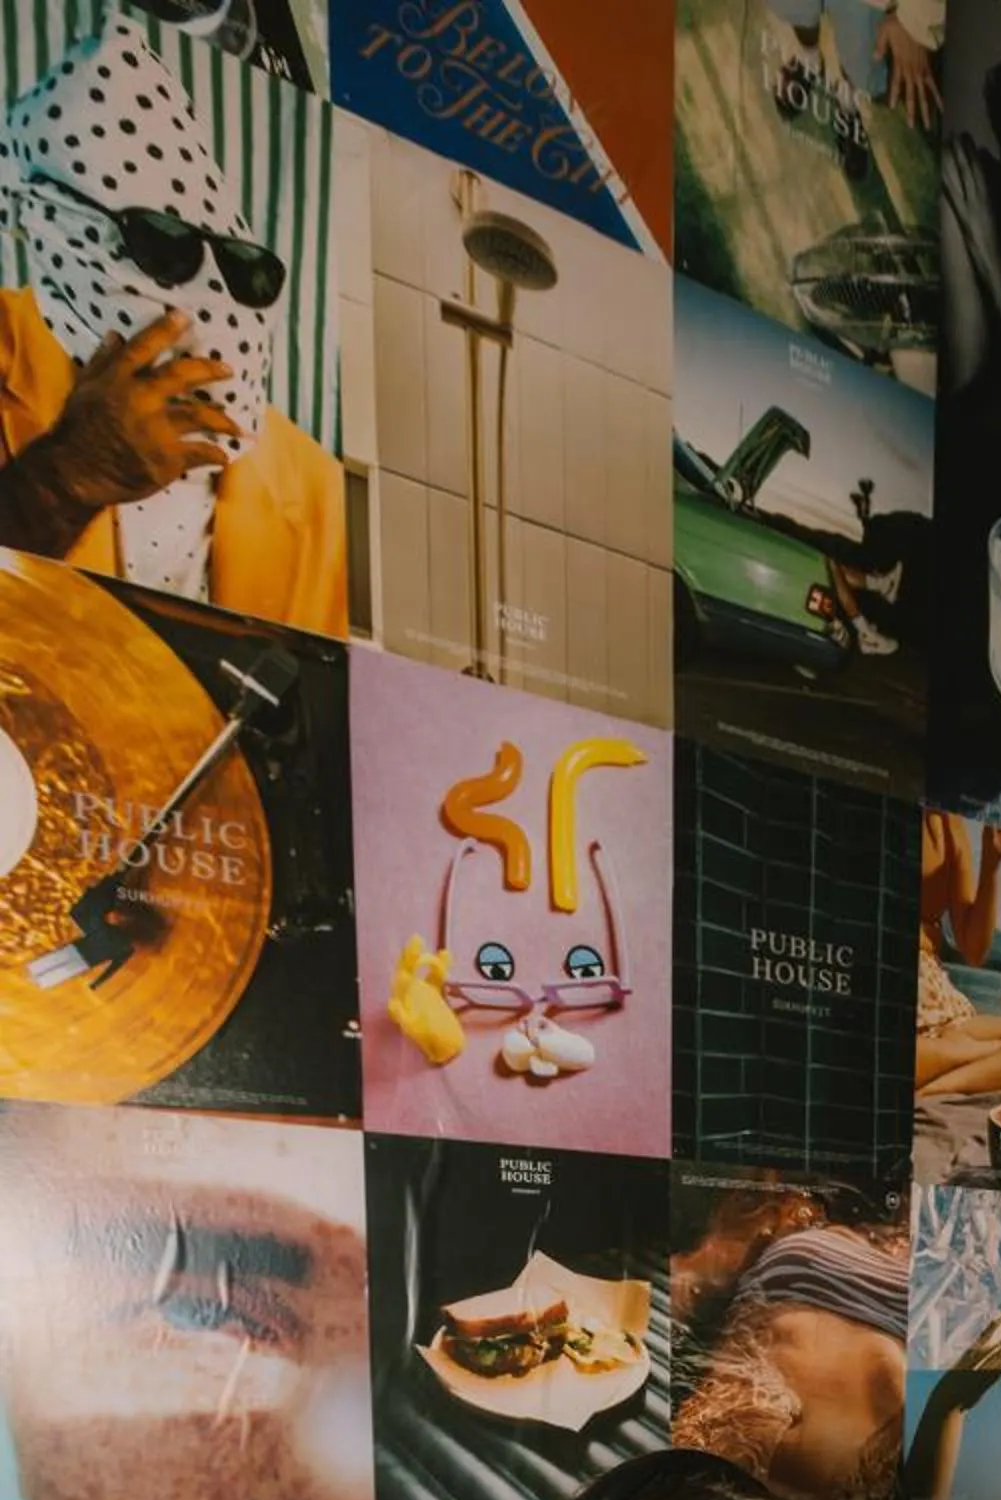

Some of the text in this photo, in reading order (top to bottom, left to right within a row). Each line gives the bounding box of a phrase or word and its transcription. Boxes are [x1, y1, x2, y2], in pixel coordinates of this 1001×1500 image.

[358, 22, 433, 80] TO
[73, 790, 248, 850] PUBLIC
[75, 828, 248, 886] HOUSE
[751, 927, 855, 969] PUBLIC
[752, 955, 853, 996] HOUSE
[500, 1158, 553, 1173] PUBLIC
[501, 1170, 551, 1185] HOUSE
